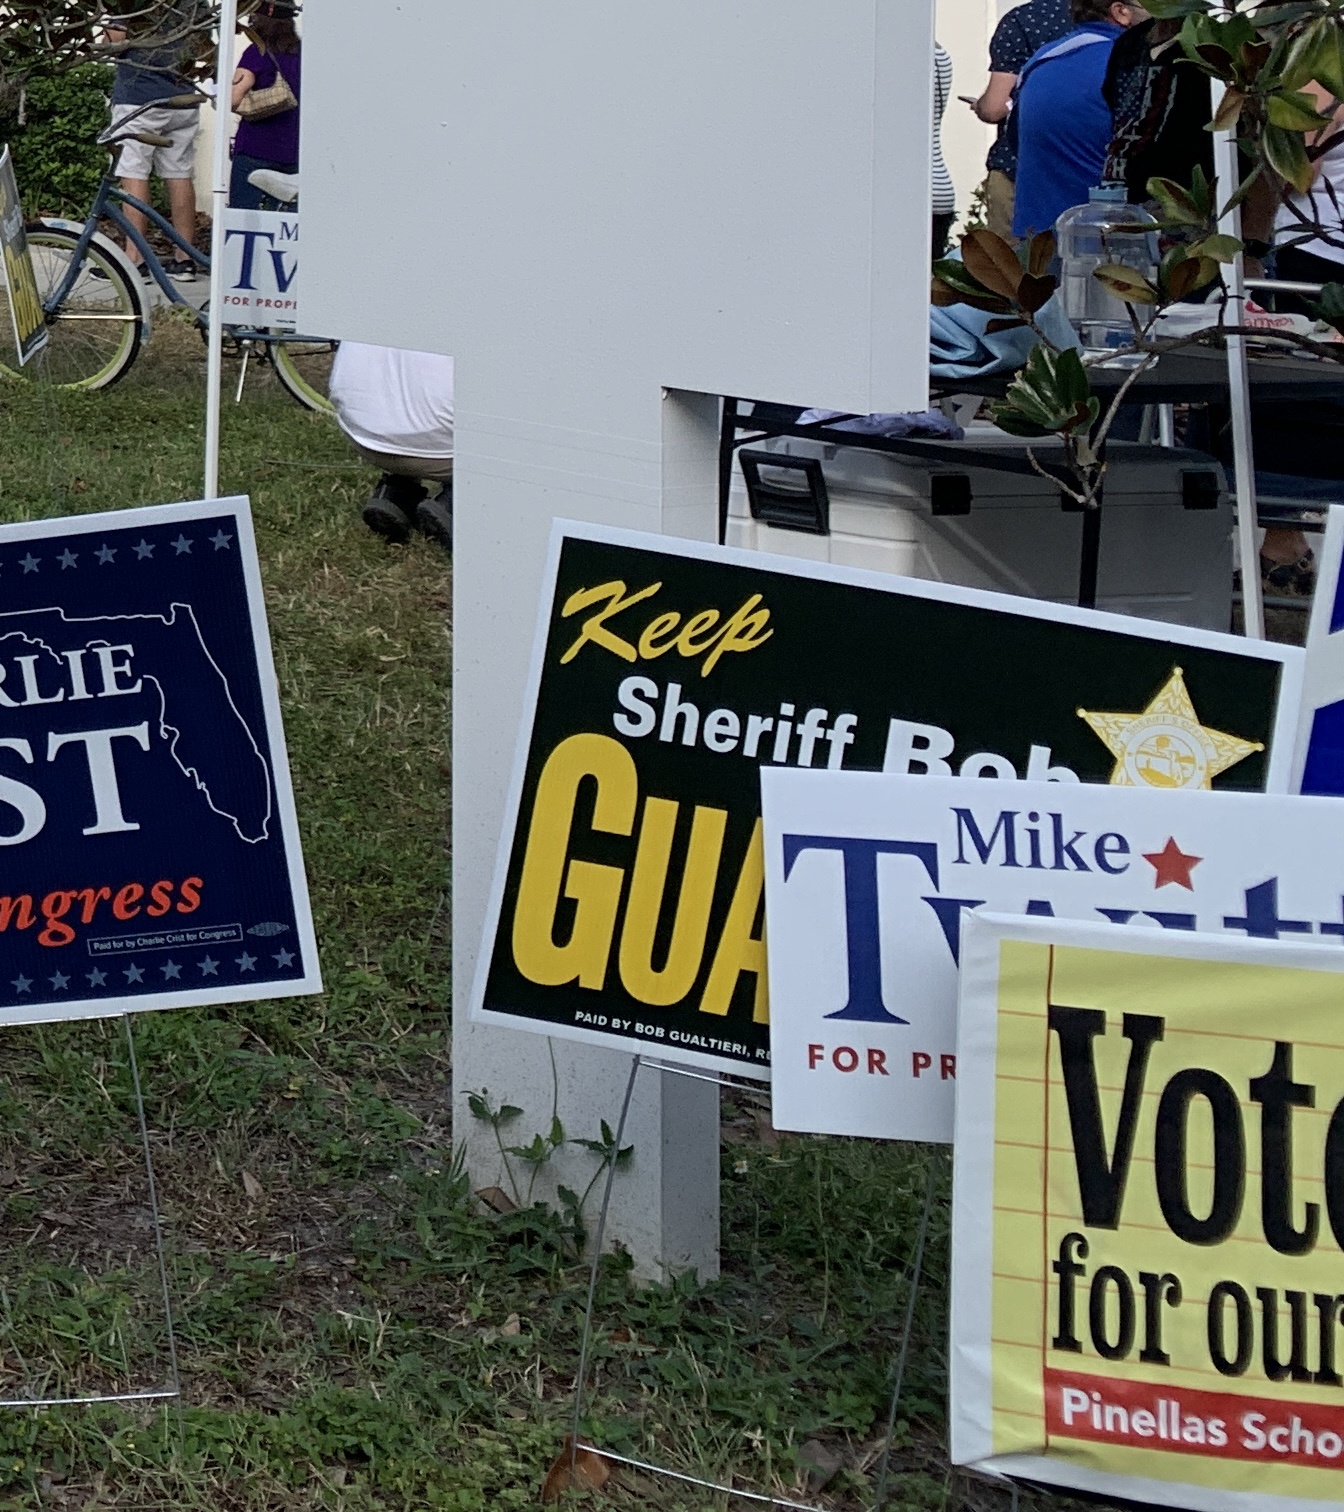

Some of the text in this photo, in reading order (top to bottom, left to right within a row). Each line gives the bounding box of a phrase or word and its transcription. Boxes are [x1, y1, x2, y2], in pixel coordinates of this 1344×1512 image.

[224, 296, 250, 306] FOR
[559, 577, 775, 678] Keep
[611, 675, 858, 769] Sheriff
[952, 806, 1132, 875] Mike
[511, 732, 767, 1026] GUA
[93, 941, 111, 951] Paid
[112, 939, 124, 949] for
[125, 939, 135, 949] by
[137, 936, 165, 947] Charlie
[166, 934, 185, 944] Crist
[186, 932, 198, 942] for
[198, 928, 237, 941] Congress
[574, 1010, 608, 1026] PAID
[612, 1018, 632, 1030] BY
[634, 1022, 666, 1037] BOB
[669, 1030, 751, 1058] GUALTIERI,
[807, 1043, 890, 1076] FOR
[1046, 1003, 1344, 1258] Vot
[1051, 1232, 1344, 1387] for our
[1061, 1388, 1344, 1460] Pinellas Scho
